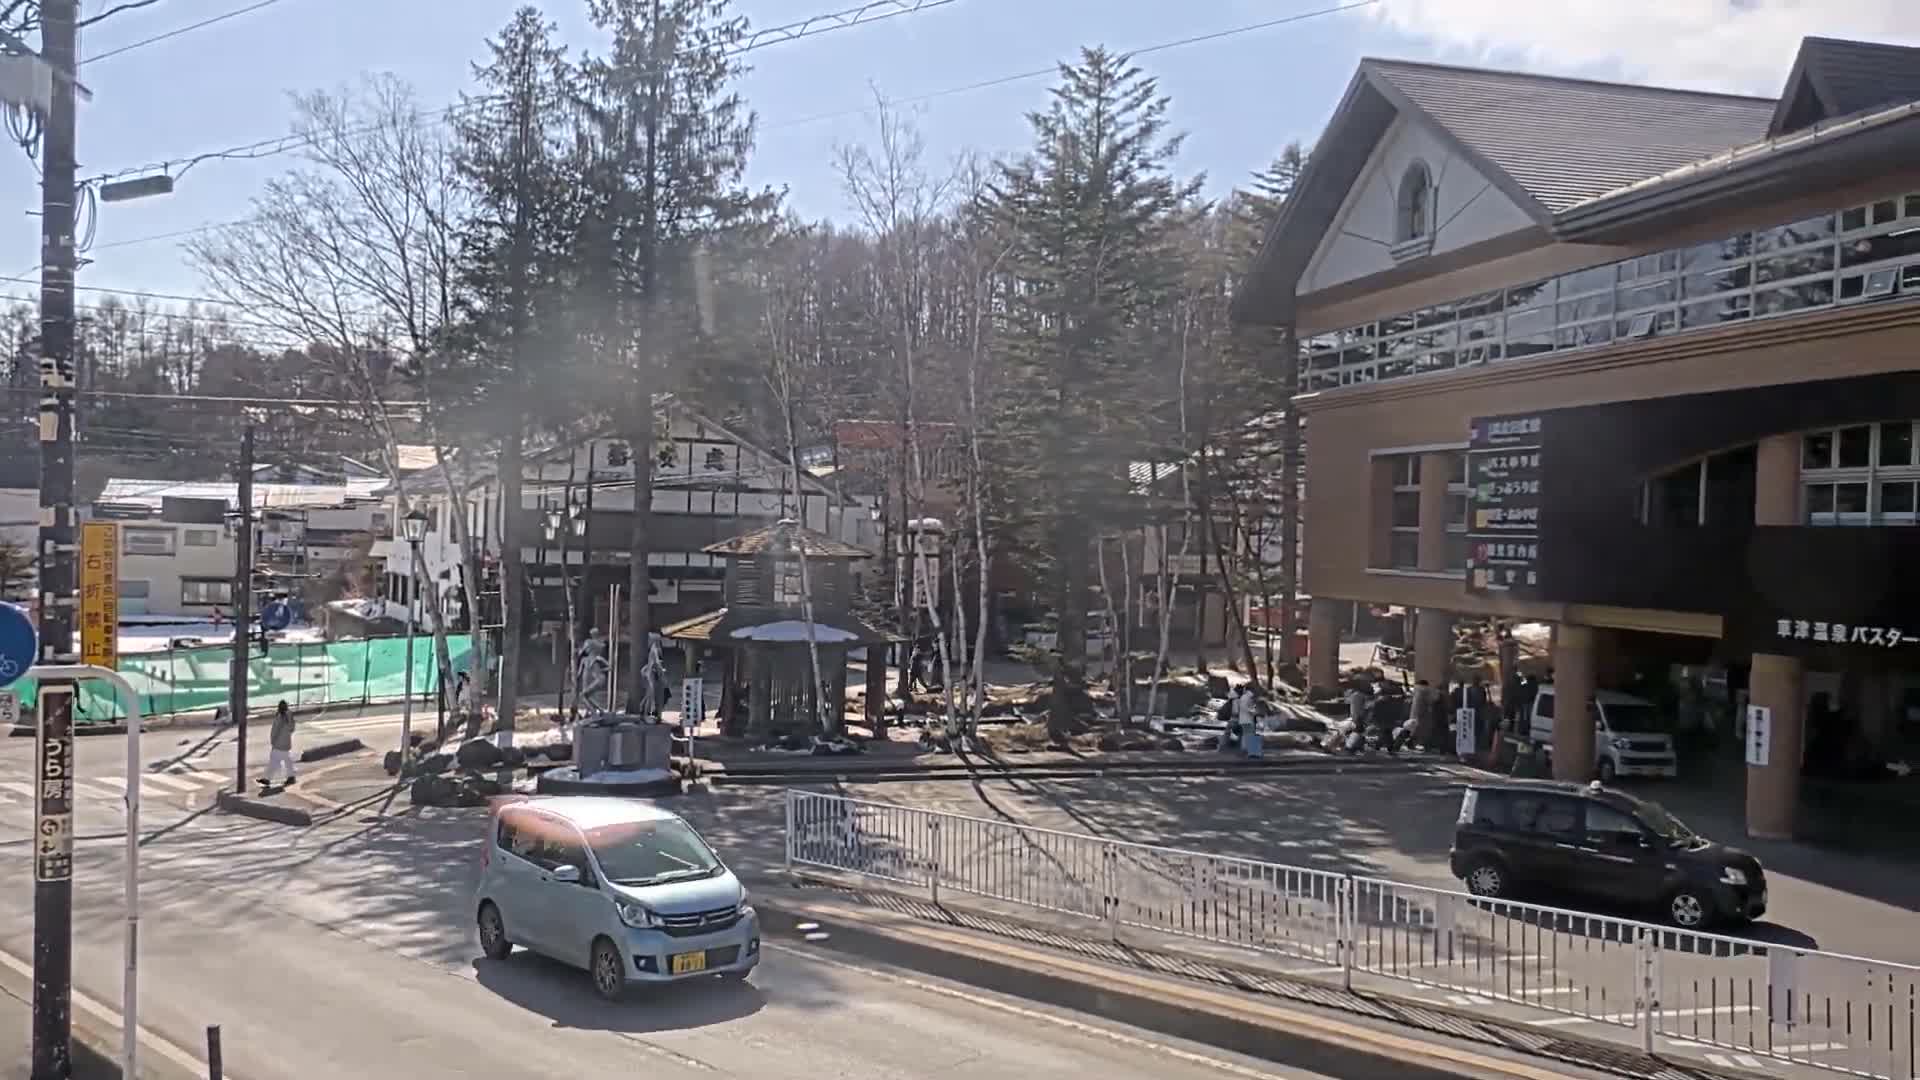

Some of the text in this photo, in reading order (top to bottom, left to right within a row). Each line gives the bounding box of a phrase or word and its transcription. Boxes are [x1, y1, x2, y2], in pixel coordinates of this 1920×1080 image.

[86, 554, 101, 657] 右折禁止
[1777, 619, 1920, 648] 草津温泉バスター
